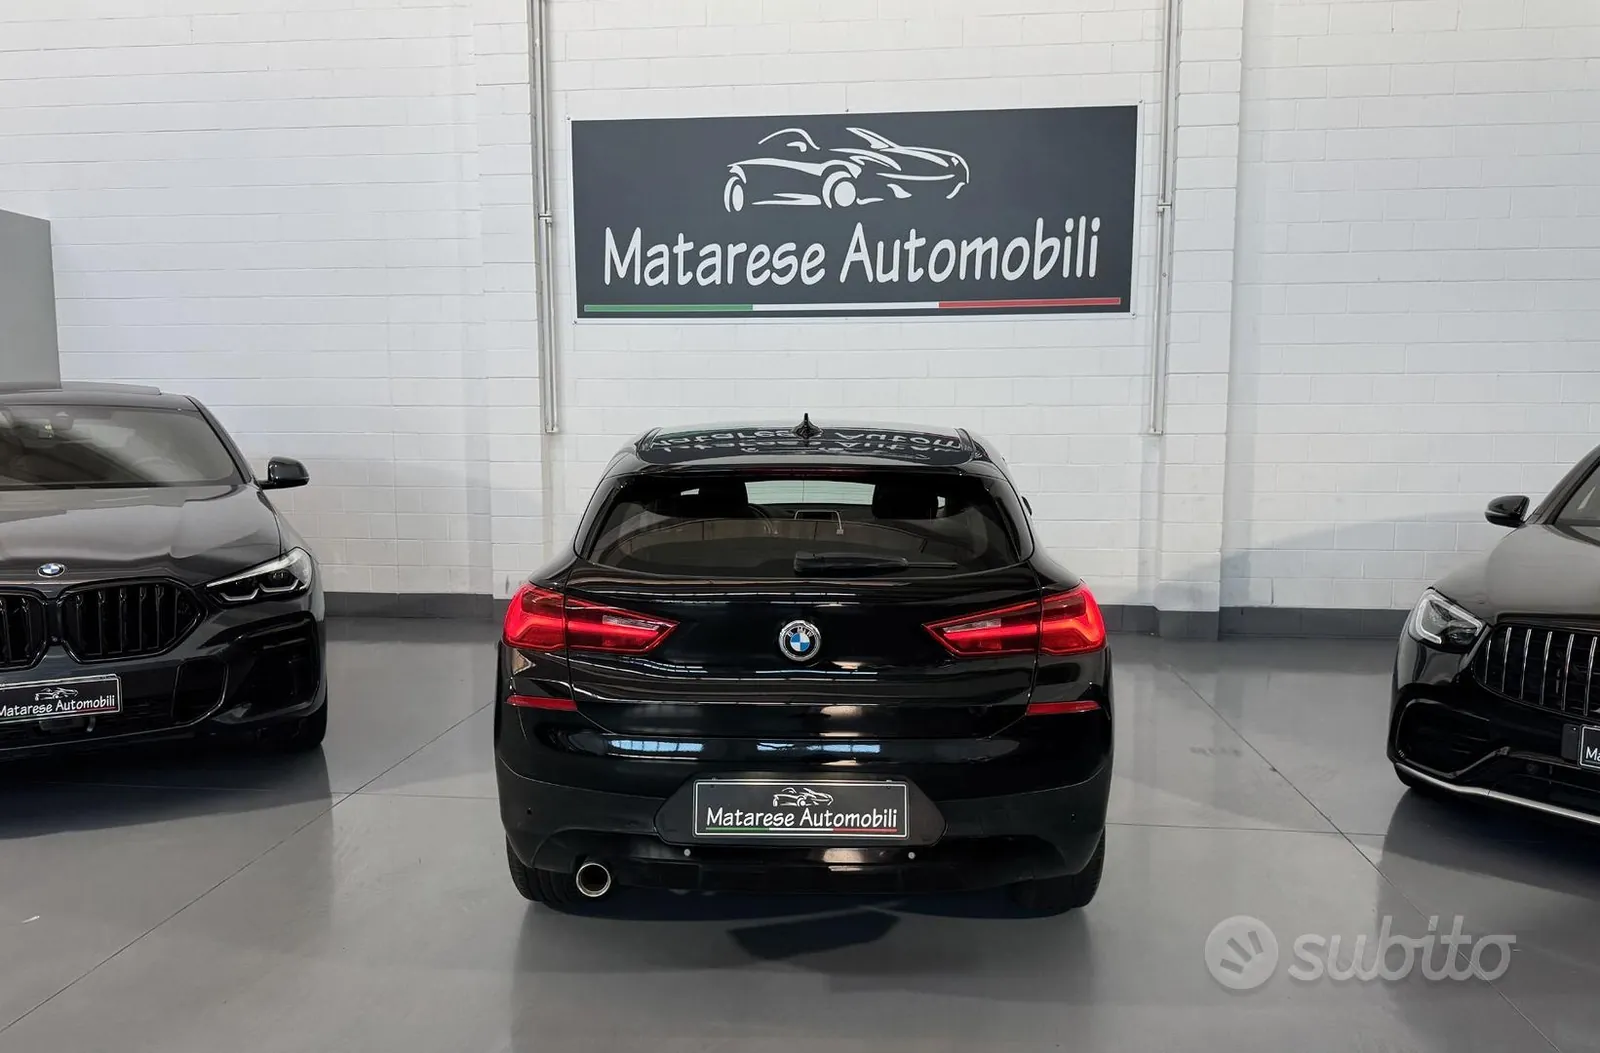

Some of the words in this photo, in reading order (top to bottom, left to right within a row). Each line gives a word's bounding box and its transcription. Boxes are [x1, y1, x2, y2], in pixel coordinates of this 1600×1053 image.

[604, 226, 826, 286] Matarese
[839, 215, 1101, 283] Automobili
[0, 703, 53, 717] Matarese
[55, 695, 115, 712] Automobili
[706, 807, 795, 828] Matarese
[799, 807, 898, 828] Automobili
